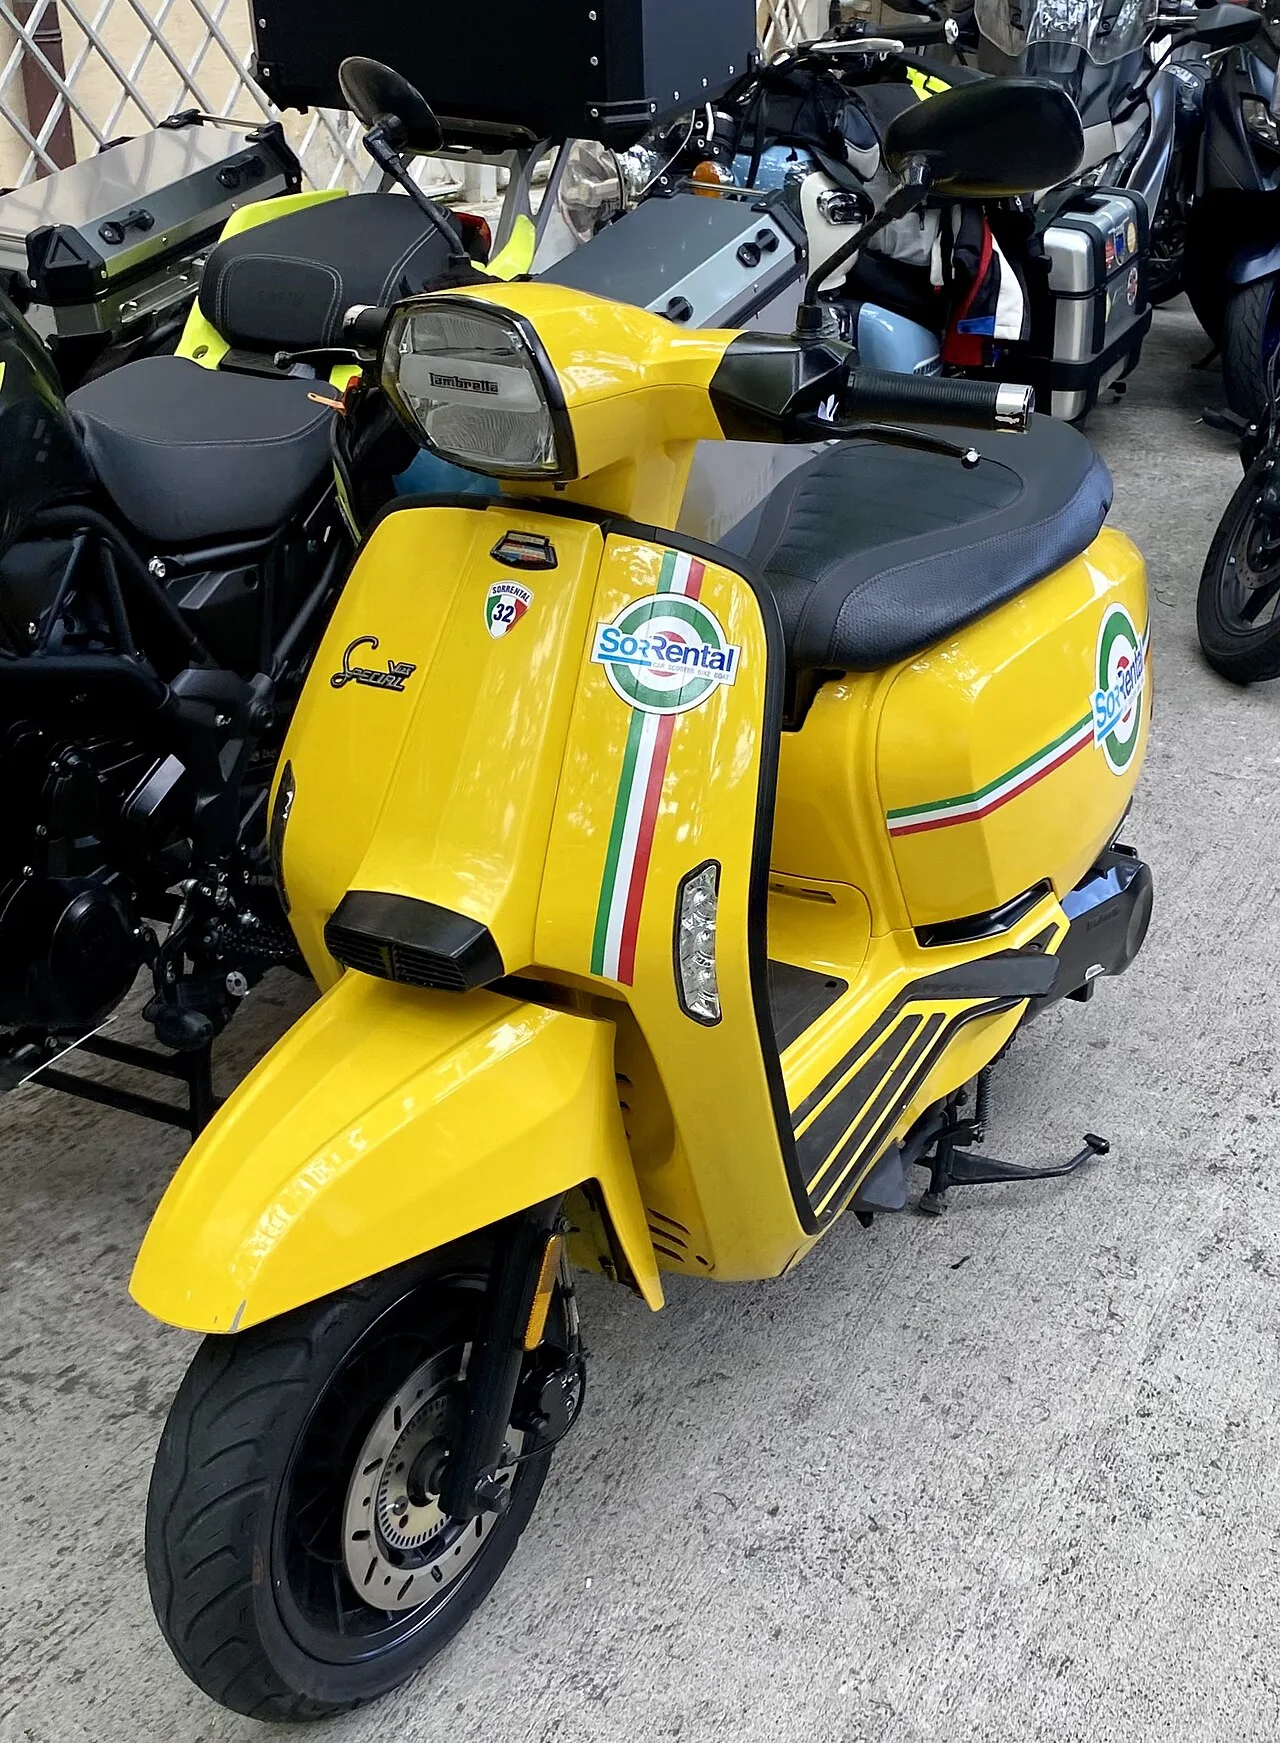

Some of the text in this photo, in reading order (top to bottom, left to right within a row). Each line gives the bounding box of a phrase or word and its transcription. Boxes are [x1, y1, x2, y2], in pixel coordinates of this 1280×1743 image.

[492, 585, 530, 602] SORRENTAL
[493, 603, 515, 623] 32
[668, 664, 695, 675] SCOOTER
[697, 668, 711, 677] BIKE
